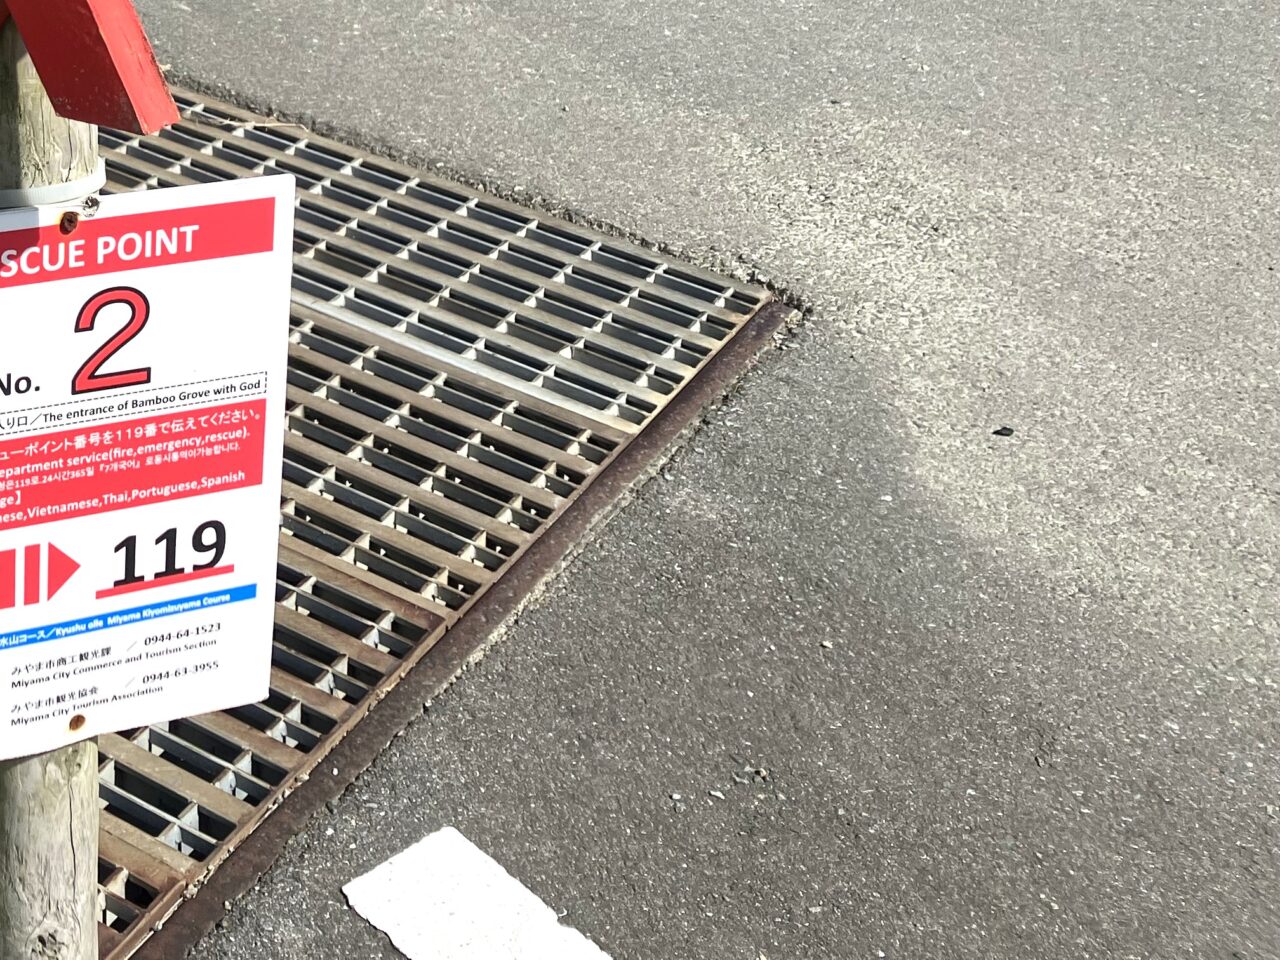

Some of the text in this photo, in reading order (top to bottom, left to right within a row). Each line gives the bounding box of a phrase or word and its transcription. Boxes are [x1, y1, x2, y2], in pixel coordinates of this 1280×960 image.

[96, 225, 200, 266] POINT
[71, 286, 151, 395] 2
[43, 413, 63, 423] The
[66, 404, 114, 419] entrance
[117, 401, 129, 411] of
[131, 394, 176, 409] Bamboo
[178, 389, 211, 401] Grove
[213, 383, 237, 396] with
[239, 379, 261, 391] God
[114, 520, 226, 588] 119
[56, 623, 87, 637] Kyushu
[107, 612, 141, 625] Miyama
[202, 594, 230, 606] Course
[144, 622, 221, 646] 0944-64-1523
[11, 639, 217, 689] Miyama City Commerce and Tourism Section
[142, 660, 219, 684] 0944-63-3955
[10, 685, 163, 727] Miyama City Tourism Association
